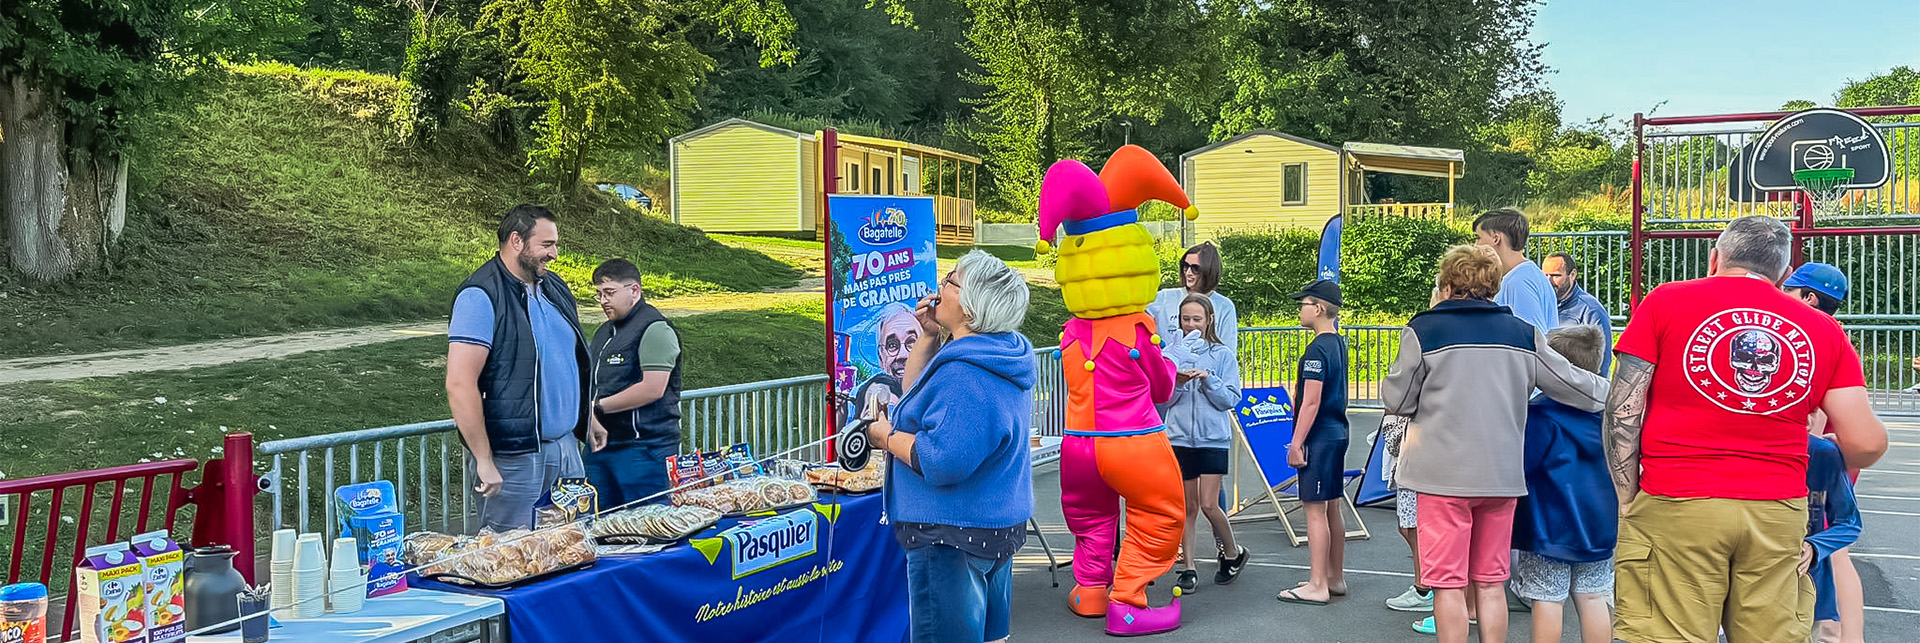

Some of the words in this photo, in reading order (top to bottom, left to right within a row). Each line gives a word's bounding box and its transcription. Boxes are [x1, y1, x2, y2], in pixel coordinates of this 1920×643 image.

[1850, 143, 1871, 151] SPORT
[863, 226, 903, 241] Bagatelle
[852, 250, 885, 280] 70
[887, 250, 910, 267] ANS
[843, 280, 869, 295] MAIS
[869, 275, 888, 288] PAS
[888, 268, 911, 284] PRÈS
[843, 297, 857, 309] DE
[1689, 318, 1725, 373] STREET
[1731, 312, 1783, 331] GLIDE
[1785, 328, 1810, 388] NATION
[734, 520, 812, 563] Pasquier
[166, 552, 180, 560] PACK
[120, 565, 138, 574] PACK
[694, 602, 734, 623] Notre
[733, 585, 773, 611] histoire
[773, 577, 788, 595] est
[787, 571, 810, 590] aussi
[809, 565, 821, 581] la
